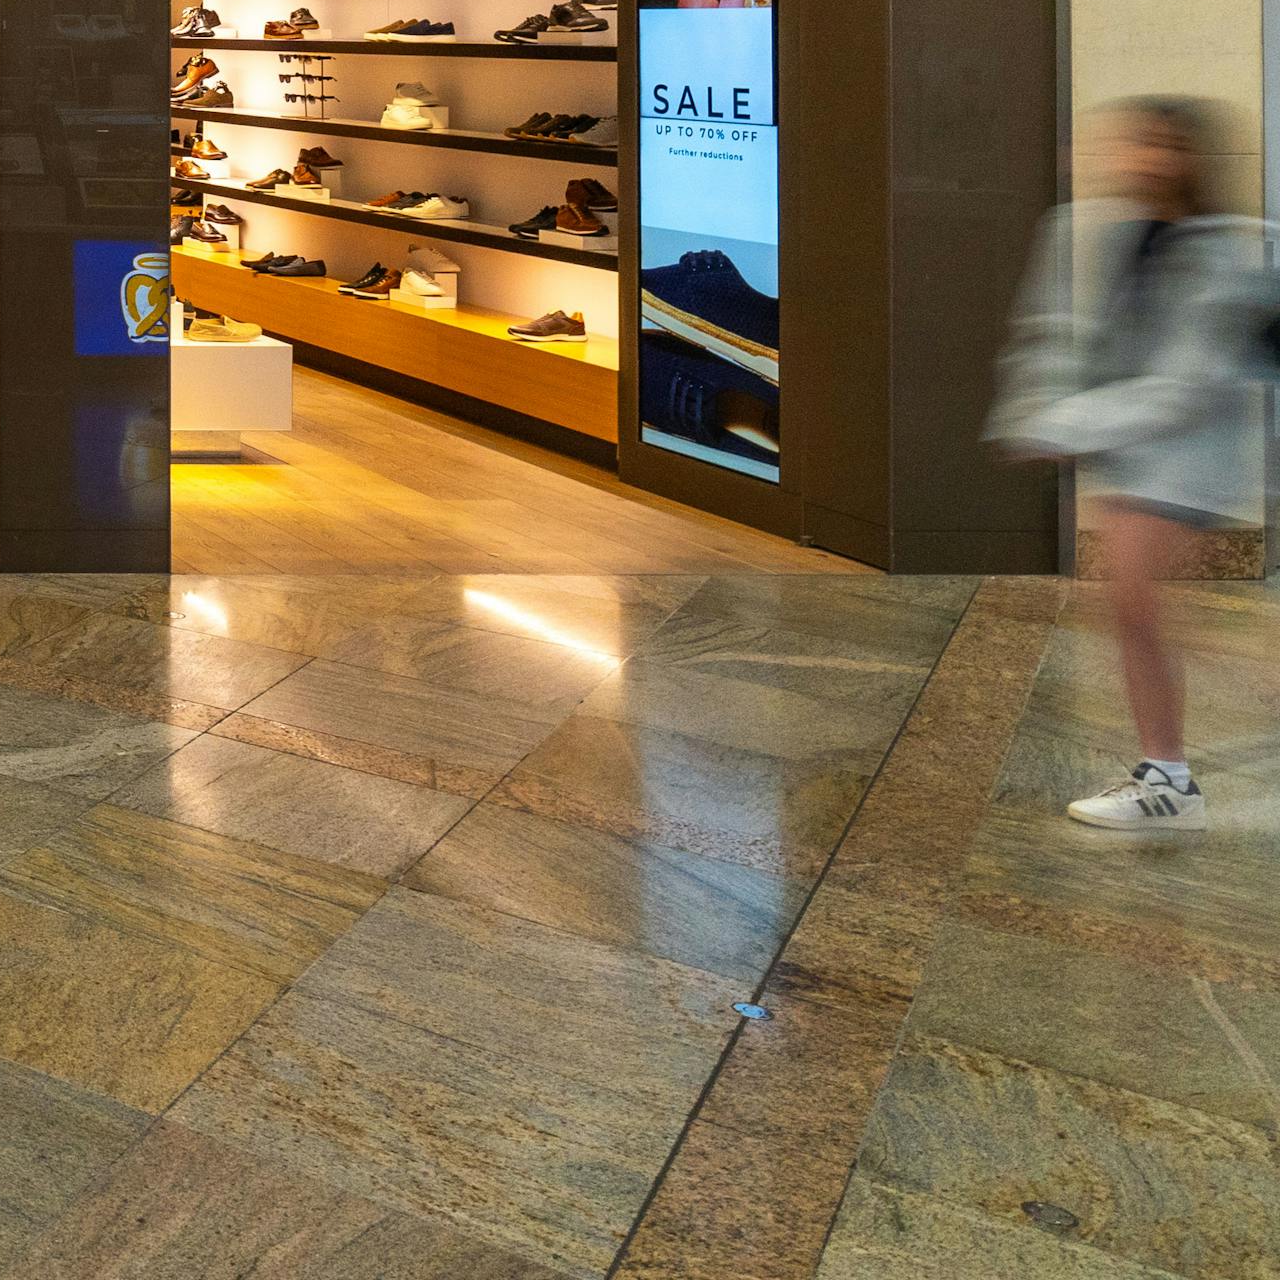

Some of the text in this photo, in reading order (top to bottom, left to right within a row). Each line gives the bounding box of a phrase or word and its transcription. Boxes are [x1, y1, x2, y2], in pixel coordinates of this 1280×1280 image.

[653, 84, 751, 120] SALE
[656, 125, 758, 142] UP TO 70% OFF
[669, 147, 744, 161] Further reductions
